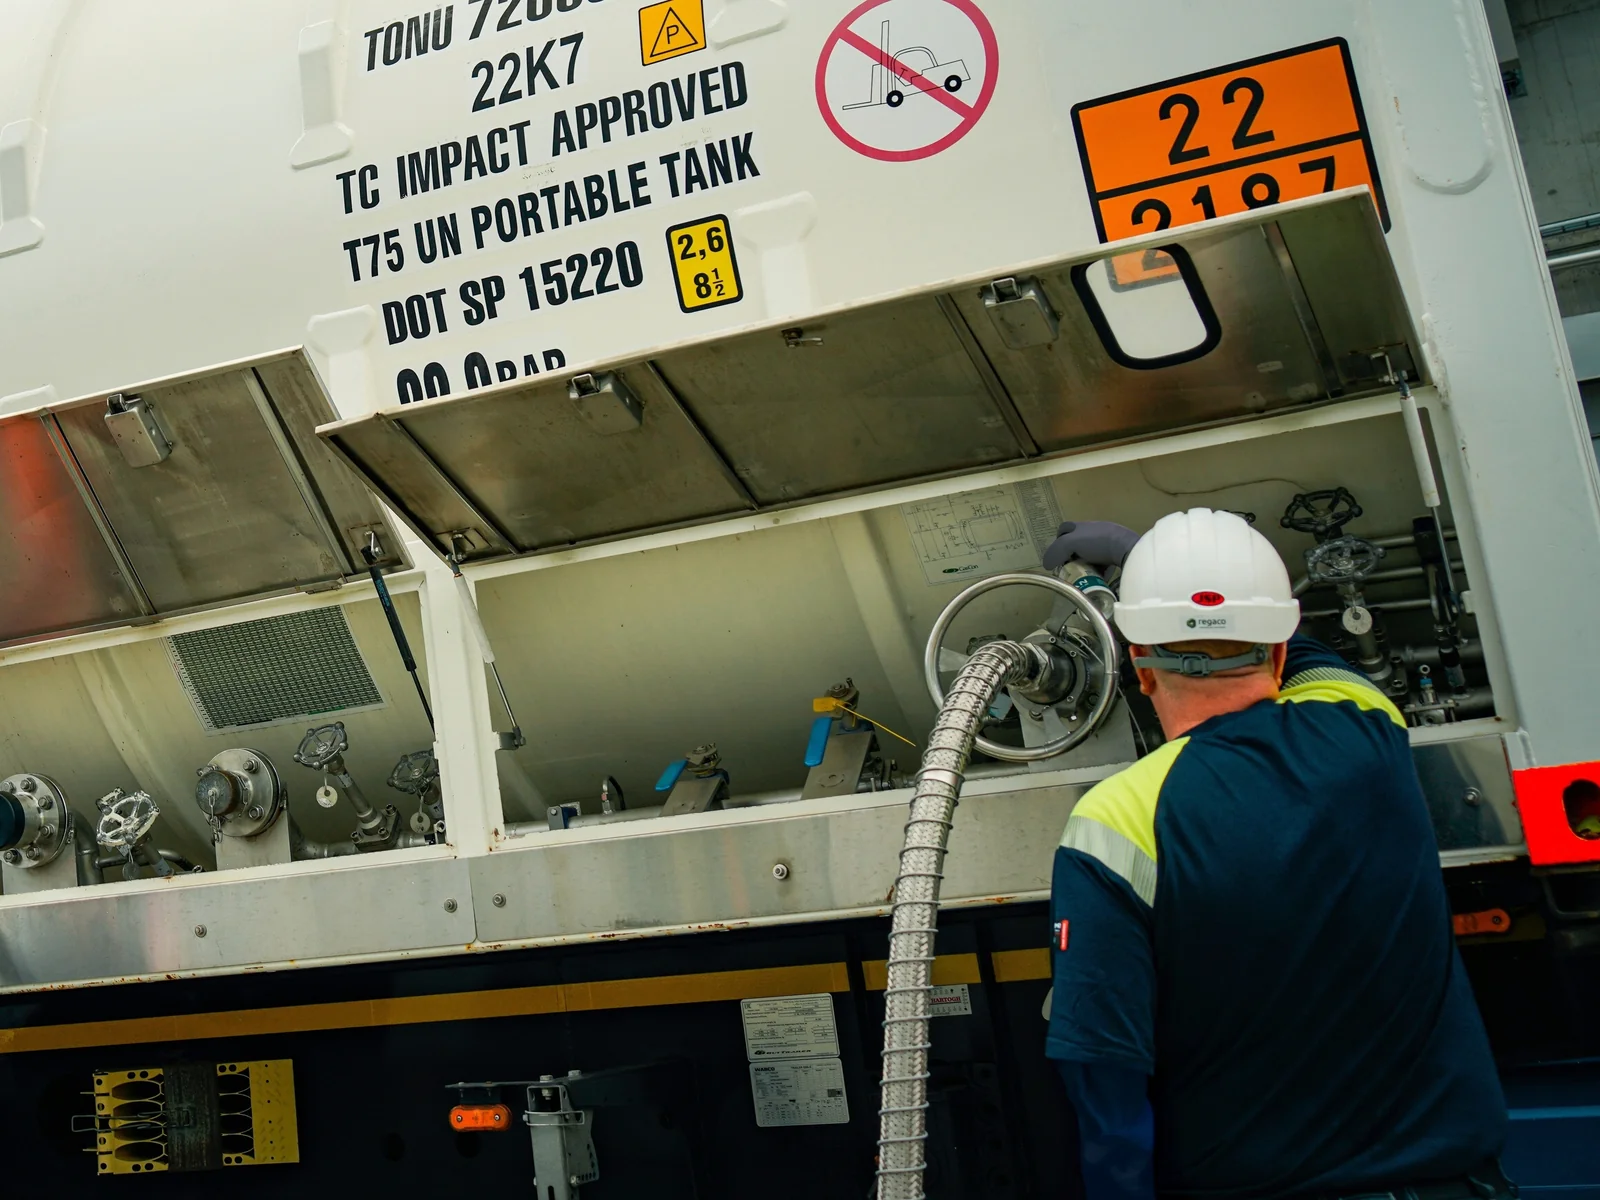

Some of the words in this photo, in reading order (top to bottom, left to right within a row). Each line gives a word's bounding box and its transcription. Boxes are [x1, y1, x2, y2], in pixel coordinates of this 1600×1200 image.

[364, 5, 454, 71] TONU
[471, 32, 584, 113] 22K7
[336, 164, 380, 214] TC
[396, 120, 531, 199] IMPACT
[551, 61, 748, 157] APPROVED
[1158, 77, 1275, 165] 22
[343, 228, 404, 281] T75
[414, 213, 462, 264] UN
[472, 161, 652, 249] PORTABLE
[659, 131, 760, 199] TANK
[677, 226, 724, 260] 2,6
[382, 288, 448, 345] DOT
[459, 275, 506, 326] SP
[518, 240, 643, 311] 15220
[1198, 618, 1227, 627] regaco
